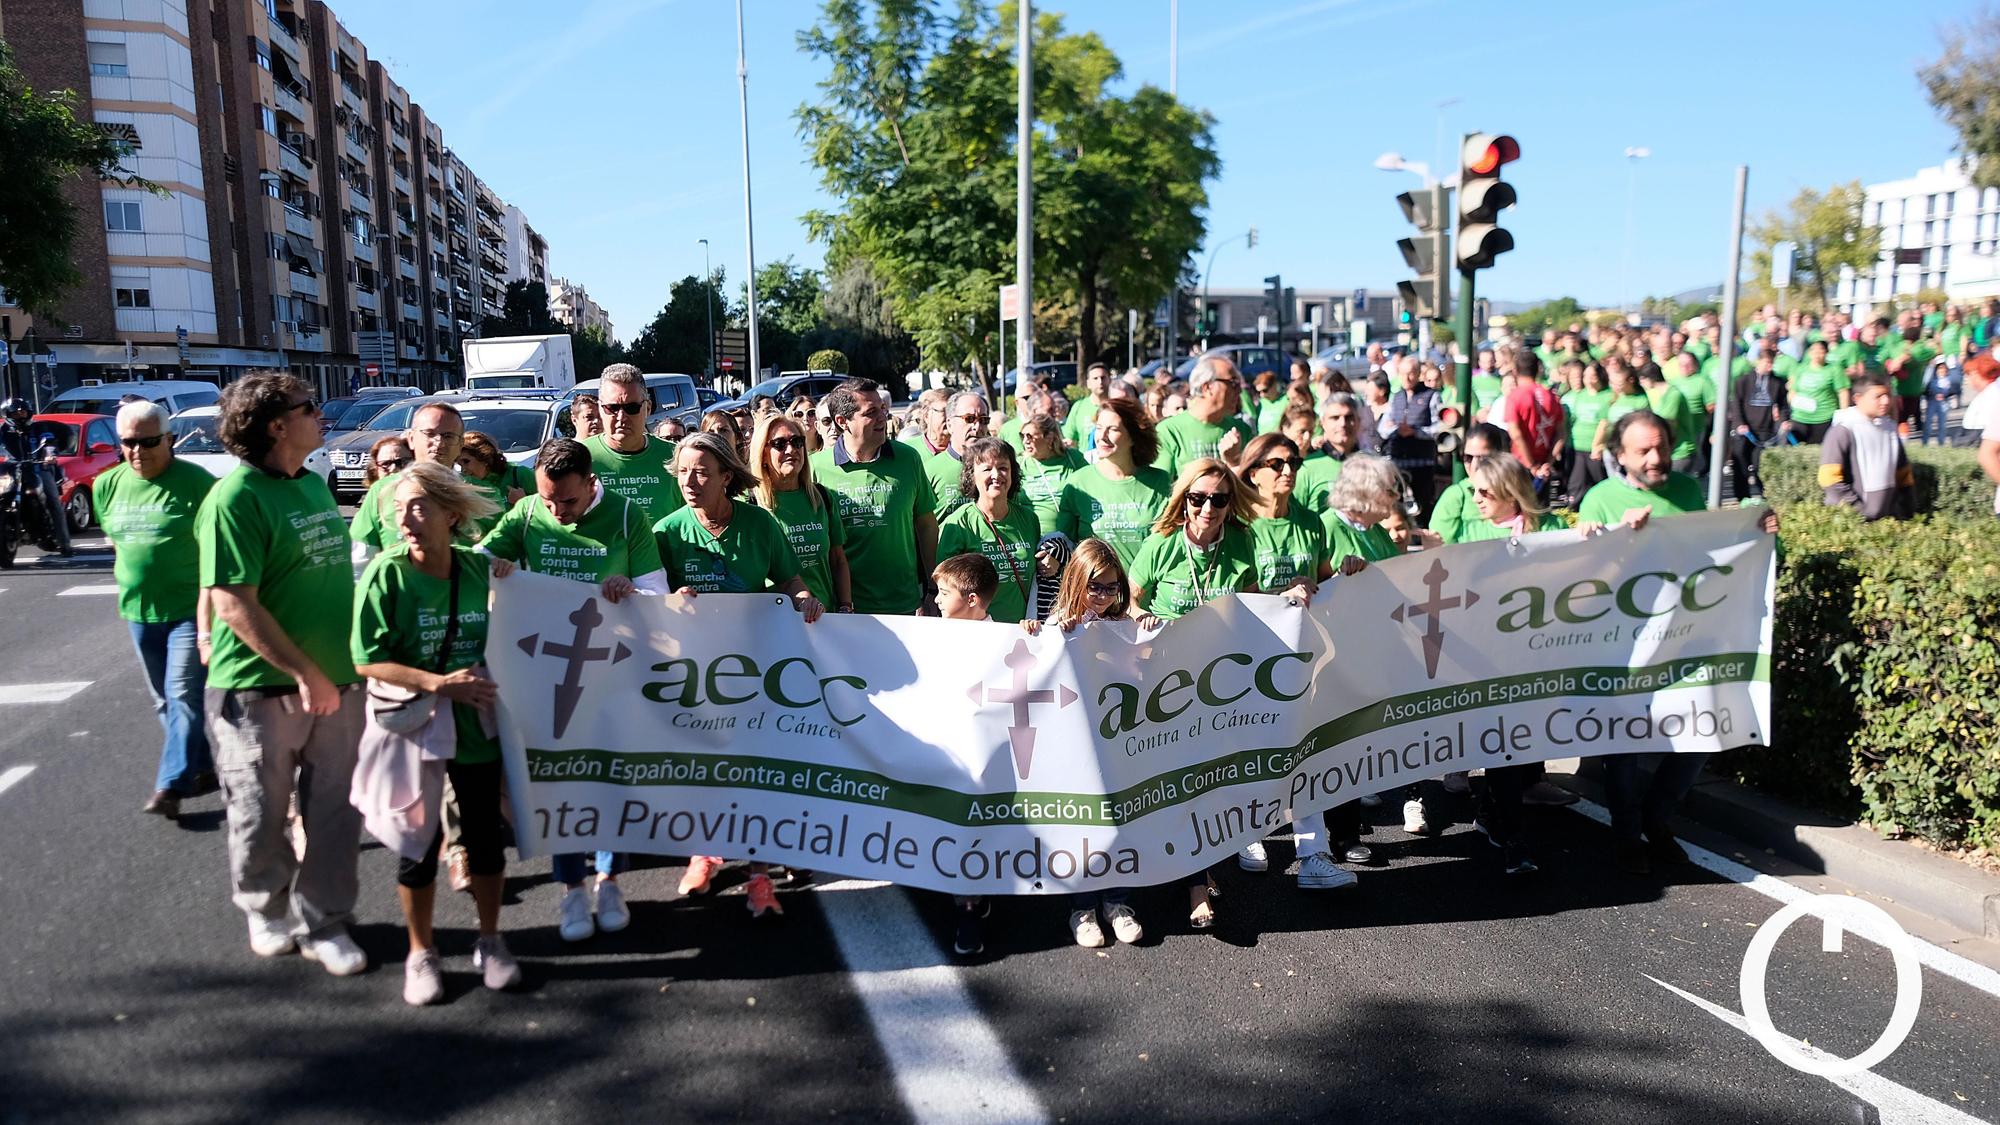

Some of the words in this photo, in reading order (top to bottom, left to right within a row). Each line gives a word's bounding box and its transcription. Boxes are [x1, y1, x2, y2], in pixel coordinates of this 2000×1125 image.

[601, 476, 616, 485] En
[619, 475, 660, 485] marcha
[837, 486, 851, 496] En
[854, 483, 893, 494] marcha
[945, 488, 958, 496] En
[839, 494, 872, 506] contra
[840, 506, 849, 516] el
[1091, 503, 1105, 511] En
[1092, 511, 1125, 520] contra
[290, 517, 309, 529] En
[1092, 520, 1101, 530] el
[1104, 520, 1139, 529] cáncer
[790, 534, 805, 543] tra
[540, 543, 556, 554] En
[560, 546, 608, 556] marcha
[982, 543, 995, 552] En
[541, 558, 579, 568] contra
[1259, 555, 1275, 565] En
[685, 563, 698, 572] En
[1262, 565, 1292, 576] contra
[554, 569, 598, 580] cáncer
[685, 572, 725, 581] marcha
[1173, 584, 1188, 595] En
[1496, 565, 1734, 633] aecc
[418, 614, 438, 627] En
[441, 610, 486, 625] mrcha
[421, 627, 463, 640] cona
[1528, 631, 1592, 651] Contra
[1603, 625, 1620, 643] el
[1632, 622, 1695, 643] Cáncer
[421, 642, 435, 654] el
[641, 653, 868, 727] aecc
[1097, 651, 1314, 740] aecc
[1383, 689, 1482, 723] Asociación
[1487, 673, 1576, 702] Española
[1581, 671, 1653, 692] Contra
[1657, 668, 1675, 686] el
[1680, 661, 1745, 683] Cáncer
[672, 712, 737, 732] Contra
[747, 711, 766, 730] el
[776, 713, 842, 740] Cáncer
[1125, 728, 1179, 757] Contra
[1188, 716, 1202, 738] el
[1211, 709, 1281, 732] Cáncer
[608, 758, 707, 785] Española
[713, 760, 786, 787] Contra
[791, 768, 812, 790] el
[816, 771, 889, 801] Cáncer
[967, 798, 1093, 821] Asociación
[1100, 780, 1178, 822] Española
[1181, 762, 1239, 794] Contra
[1244, 755, 1262, 776] el
[1267, 735, 1318, 773] Cáncer
[1190, 797, 1282, 857] Junta
[1289, 721, 1465, 809] Provincial
[1480, 716, 1532, 755] de
[1545, 700, 1734, 746] Córdoba
[535, 801, 600, 839] nta
[617, 800, 849, 858] Provincial
[862, 820, 919, 869] de
[931, 835, 1140, 880] Córdoba
